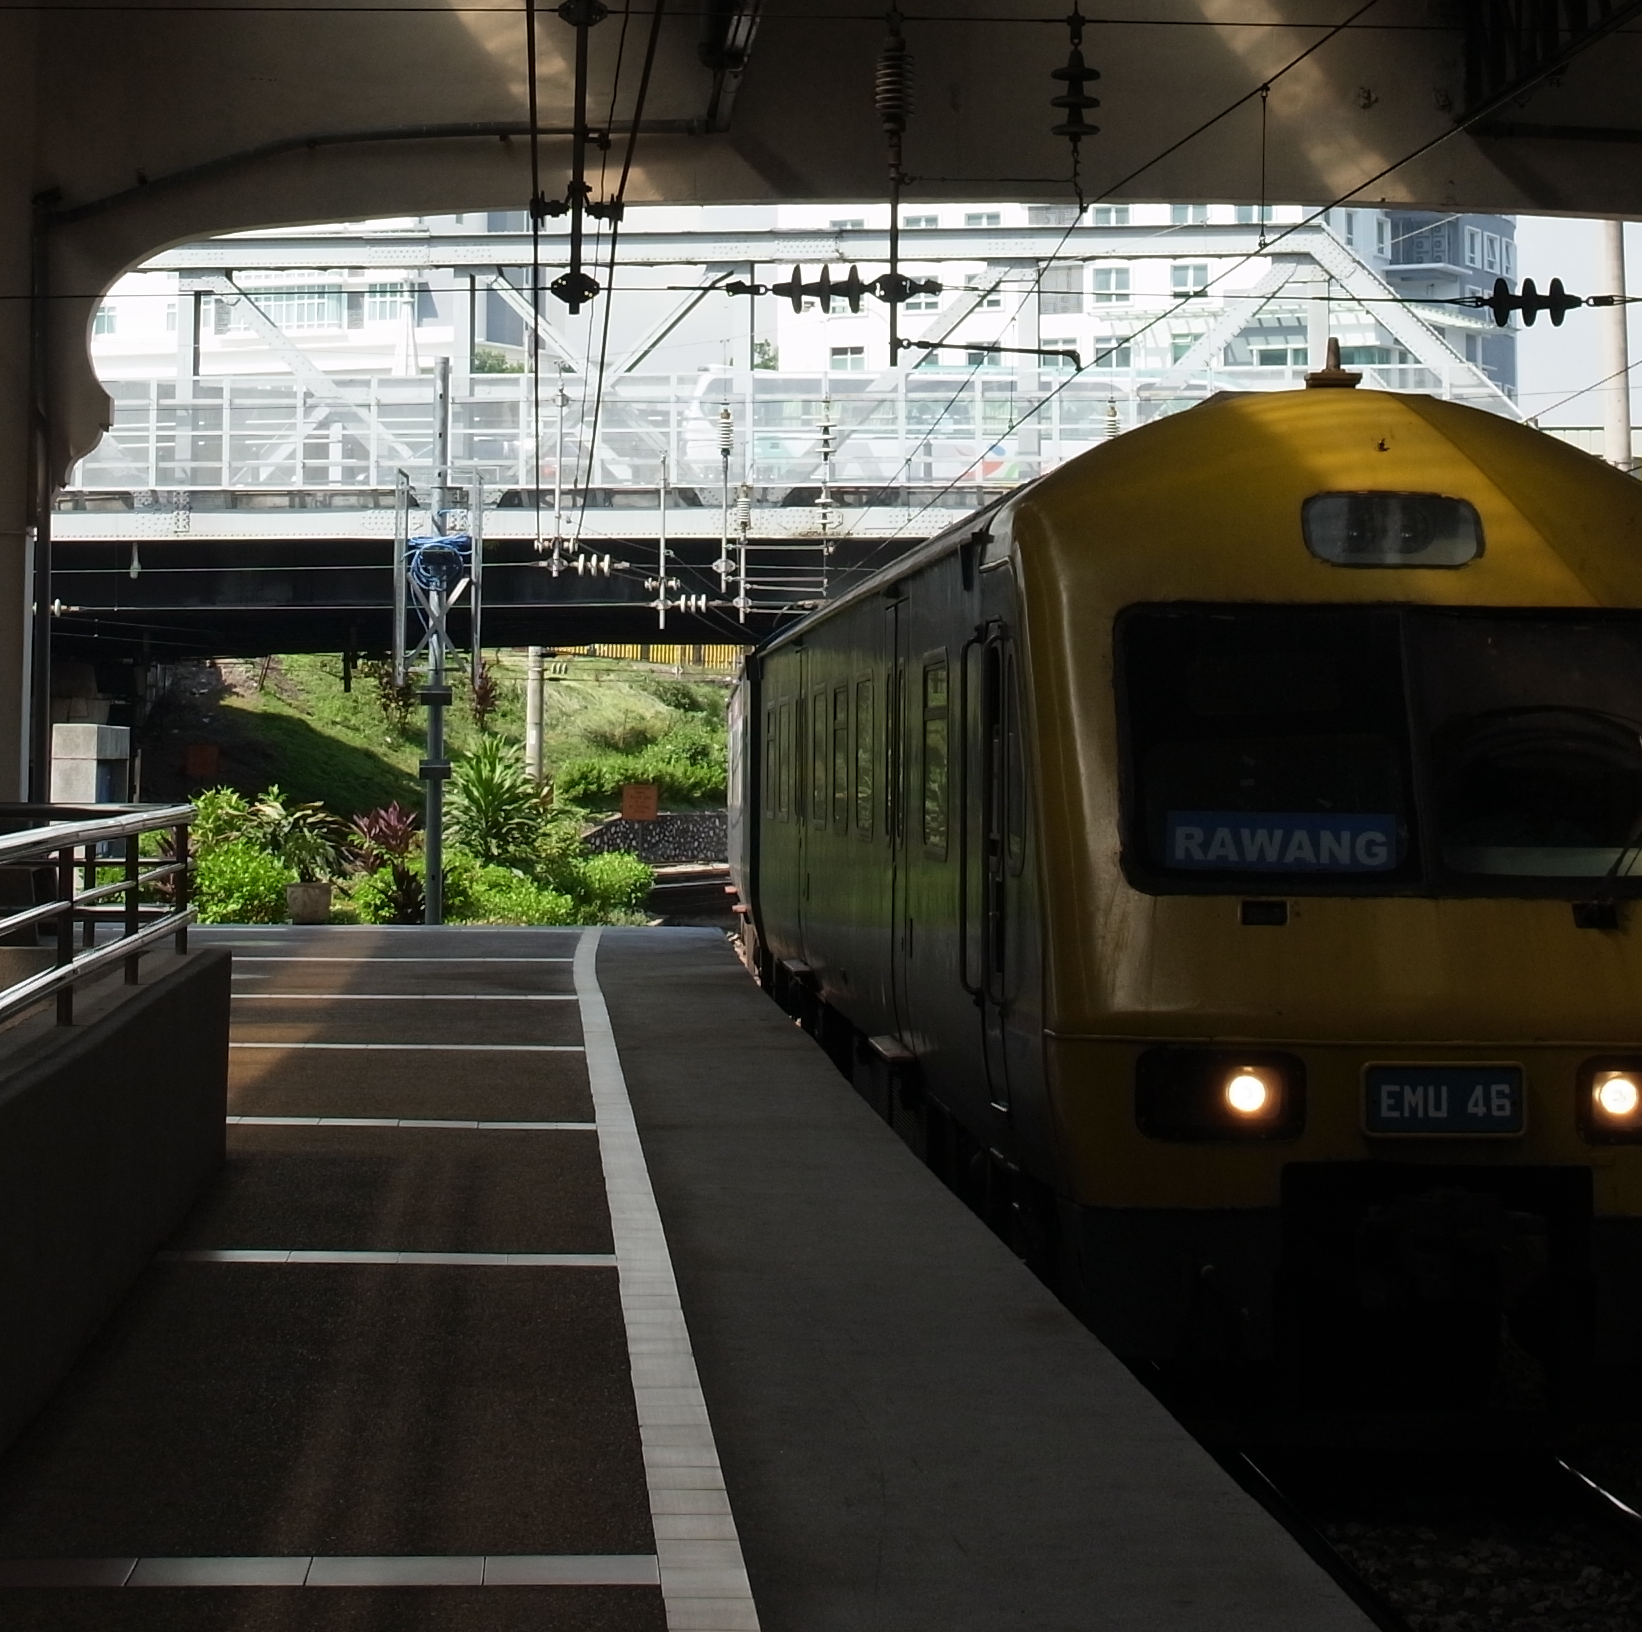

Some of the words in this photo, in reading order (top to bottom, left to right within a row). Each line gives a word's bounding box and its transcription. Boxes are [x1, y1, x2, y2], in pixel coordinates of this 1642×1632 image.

[1174, 826, 1388, 866] RAWANG
[1380, 1084, 1448, 1118] EMU
[1467, 1083, 1511, 1118] 46
